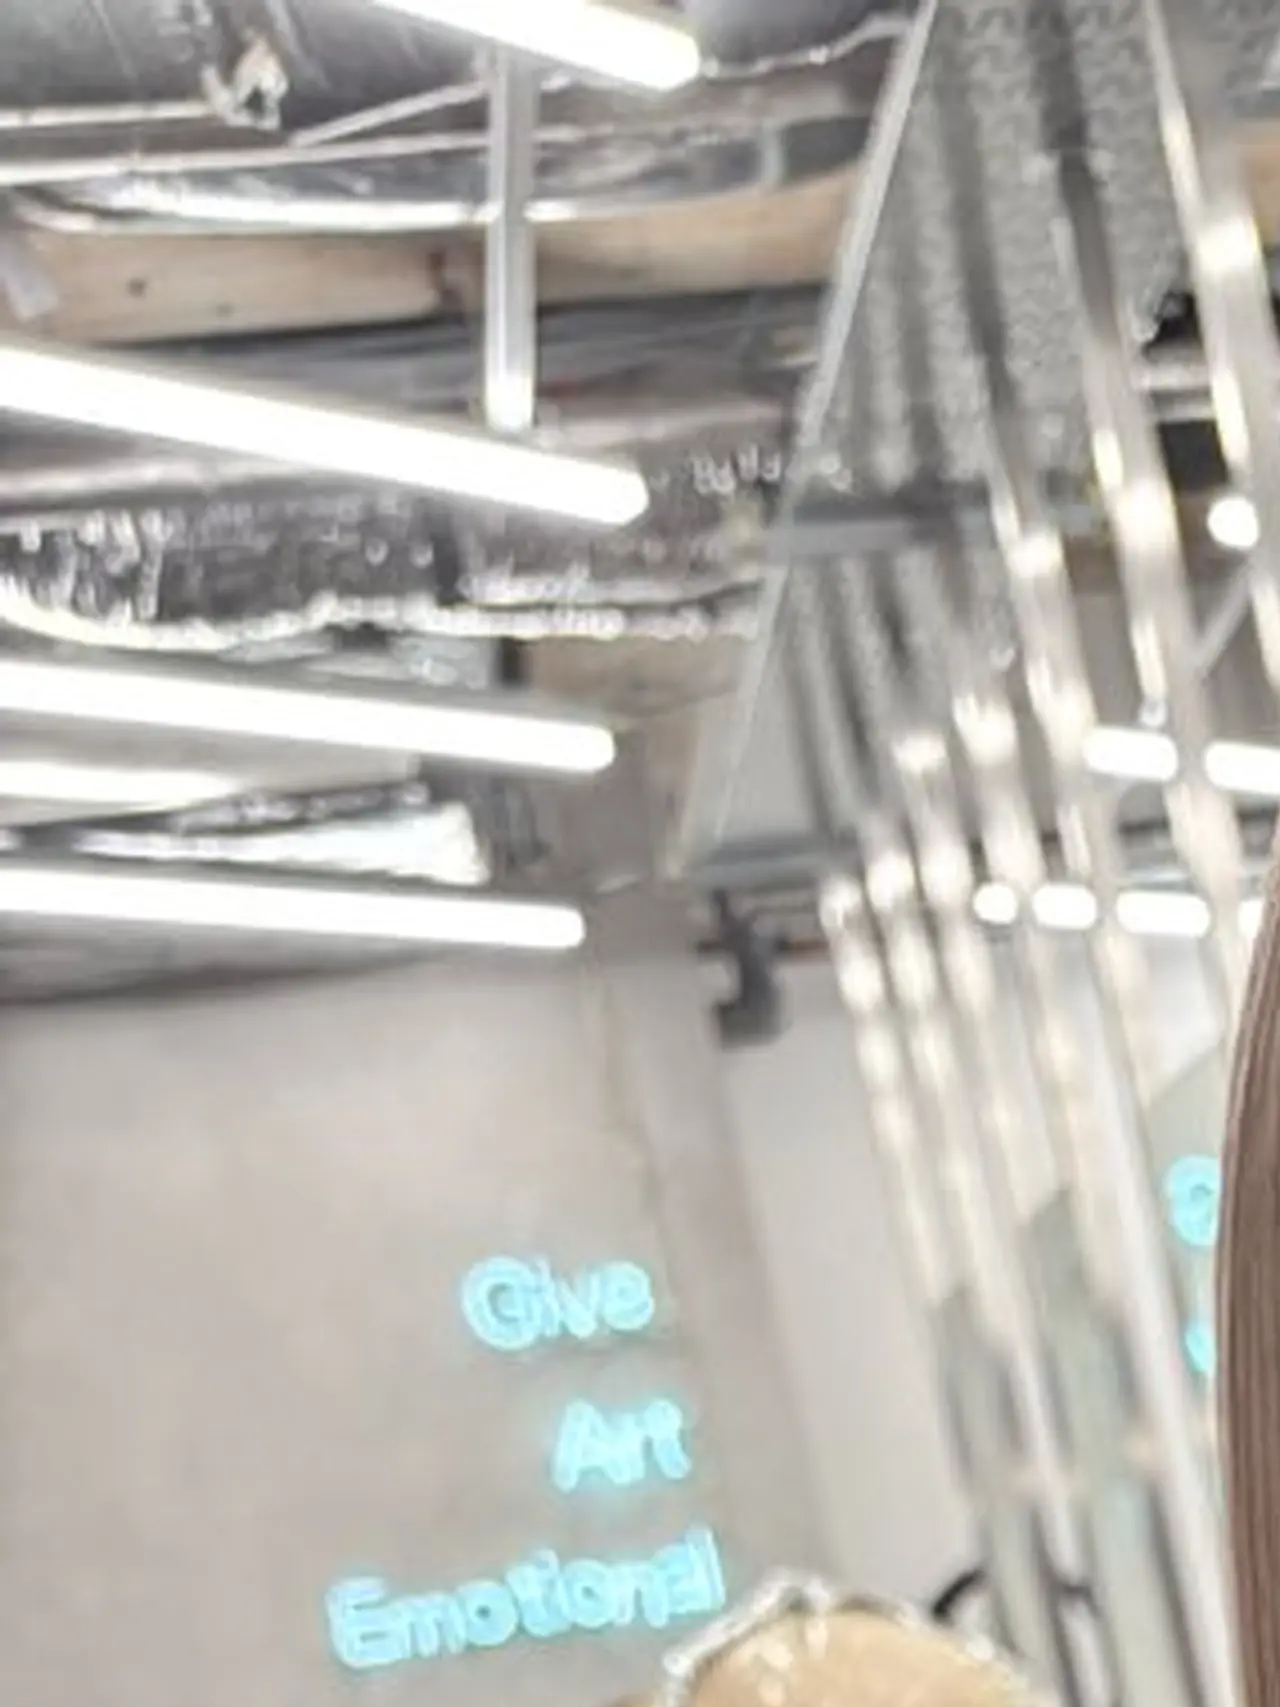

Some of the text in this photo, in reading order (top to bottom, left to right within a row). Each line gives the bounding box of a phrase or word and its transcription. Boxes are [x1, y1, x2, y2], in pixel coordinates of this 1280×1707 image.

[461, 1255, 655, 1351] Give
[551, 1397, 691, 1493] Art
[326, 1524, 727, 1668] Emotional
